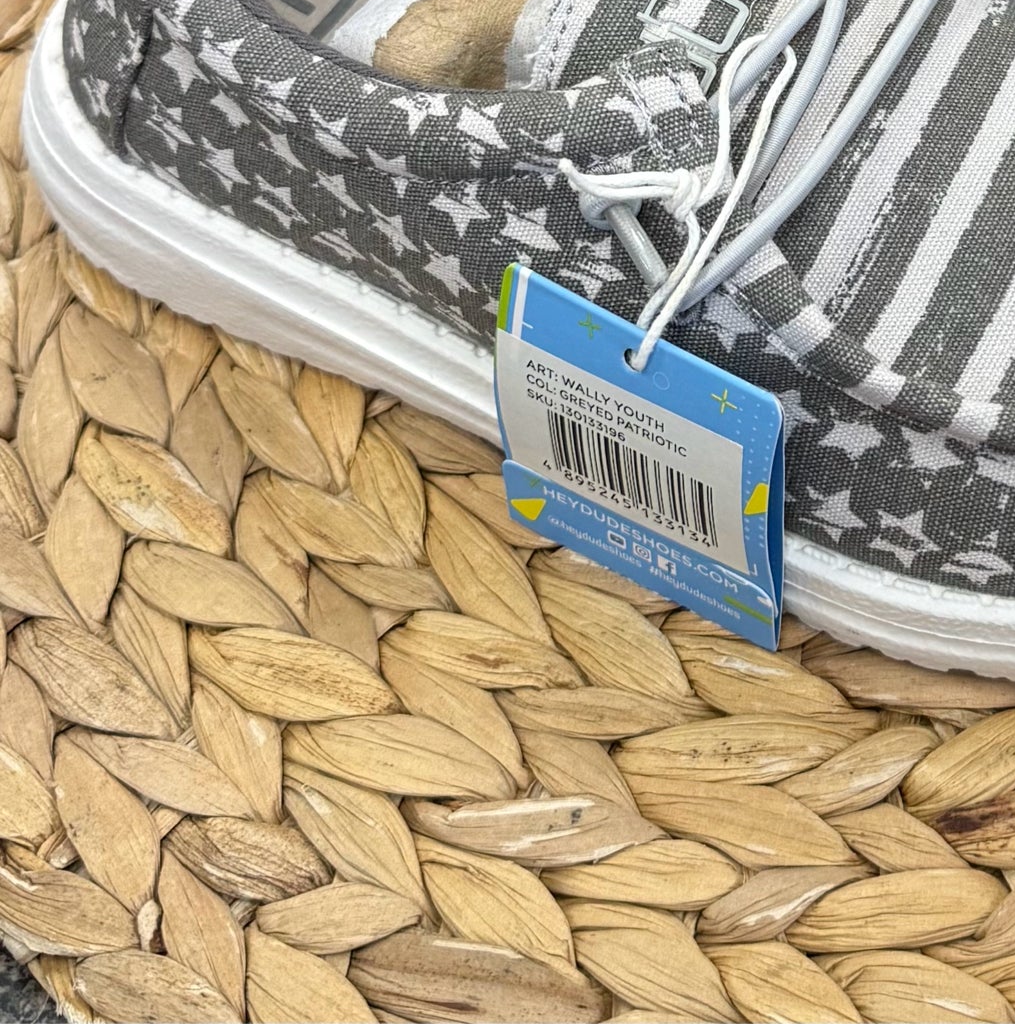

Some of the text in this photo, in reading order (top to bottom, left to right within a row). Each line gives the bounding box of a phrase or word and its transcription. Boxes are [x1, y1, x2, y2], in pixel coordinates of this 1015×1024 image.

[526, 359, 665, 433] ART: WALLY YOUTH
[526, 373, 688, 457] COL: GREYED PATRIOTIC
[527, 388, 626, 442] SKU: 130133196
[543, 485, 740, 594] HEYDUDESHOES.COM
[547, 514, 742, 620] @heydudeshoes #heydudeshoes
